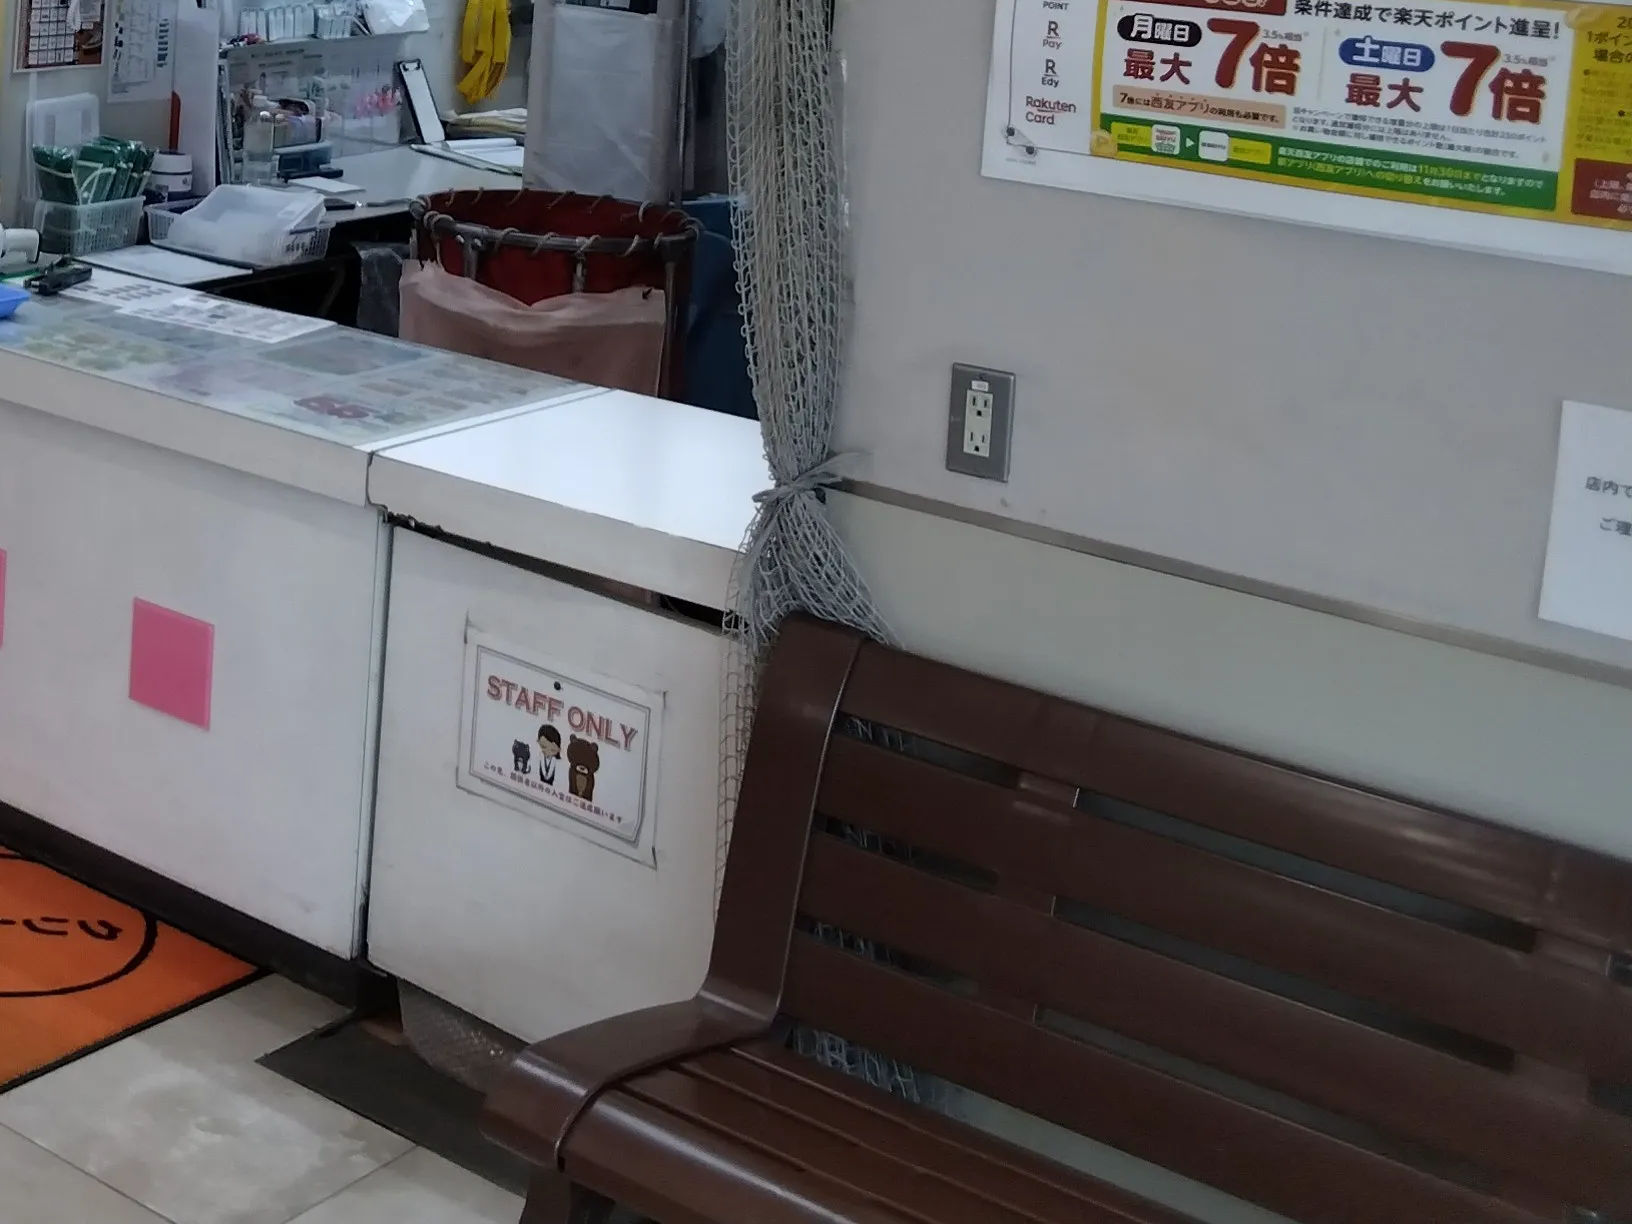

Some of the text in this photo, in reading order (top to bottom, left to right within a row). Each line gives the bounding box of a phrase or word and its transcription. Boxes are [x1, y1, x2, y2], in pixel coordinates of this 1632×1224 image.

[1043, 2, 1069, 11] POINT
[1294, 0, 1561, 39] 条件達成で楽天ポイント進呈!
[1048, 21, 1059, 36] R
[1130, 14, 1190, 43] 月曜日
[1043, 38, 1062, 50] Pay
[1353, 37, 1422, 66] 土曜日
[1123, 17, 1301, 97] 最大 7倍
[1045, 59, 1057, 75] R
[1041, 76, 1059, 88] Edy
[1345, 73, 1424, 112] 最大
[1440, 41, 1546, 125] 7倍
[1026, 96, 1076, 113] Rakuten
[1026, 113, 1055, 126] Card
[487, 675, 638, 752] STAFF ONLY
